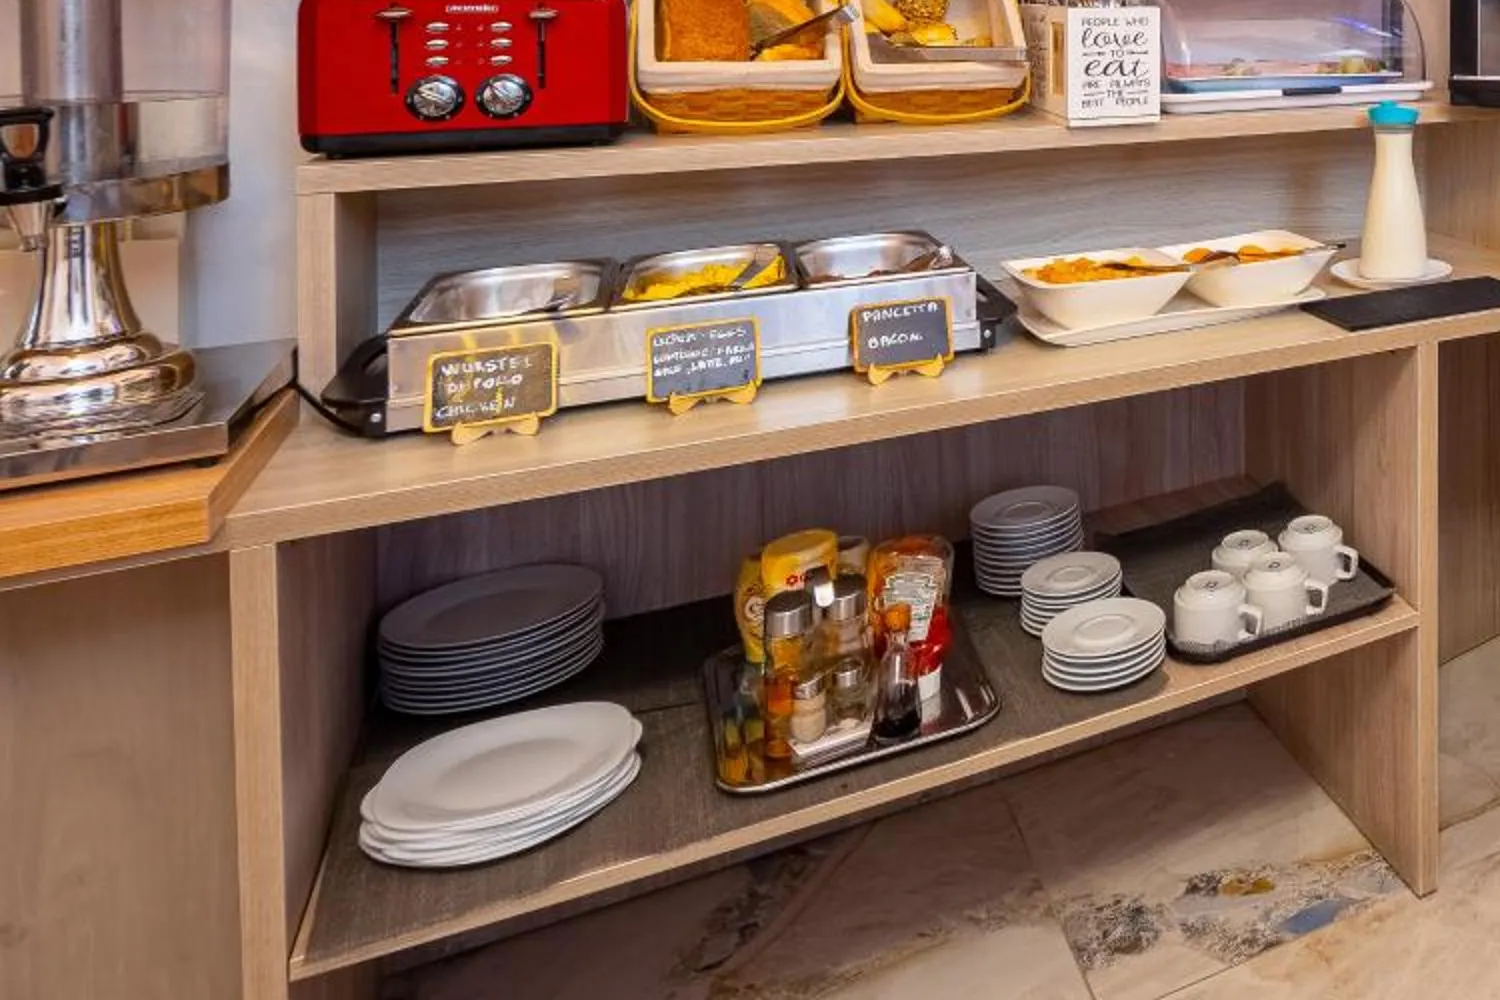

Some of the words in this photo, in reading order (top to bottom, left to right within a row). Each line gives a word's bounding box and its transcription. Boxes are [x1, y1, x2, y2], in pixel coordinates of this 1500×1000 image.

[1081, 17, 1121, 27] PEOPLE
[1125, 16, 1149, 27] WHO
[1081, 27, 1149, 49] love
[1110, 49, 1124, 58] TO
[1084, 59, 1149, 79] eat
[862, 302, 938, 322] PANCETTA
[441, 357, 533, 377] WURSTEL
